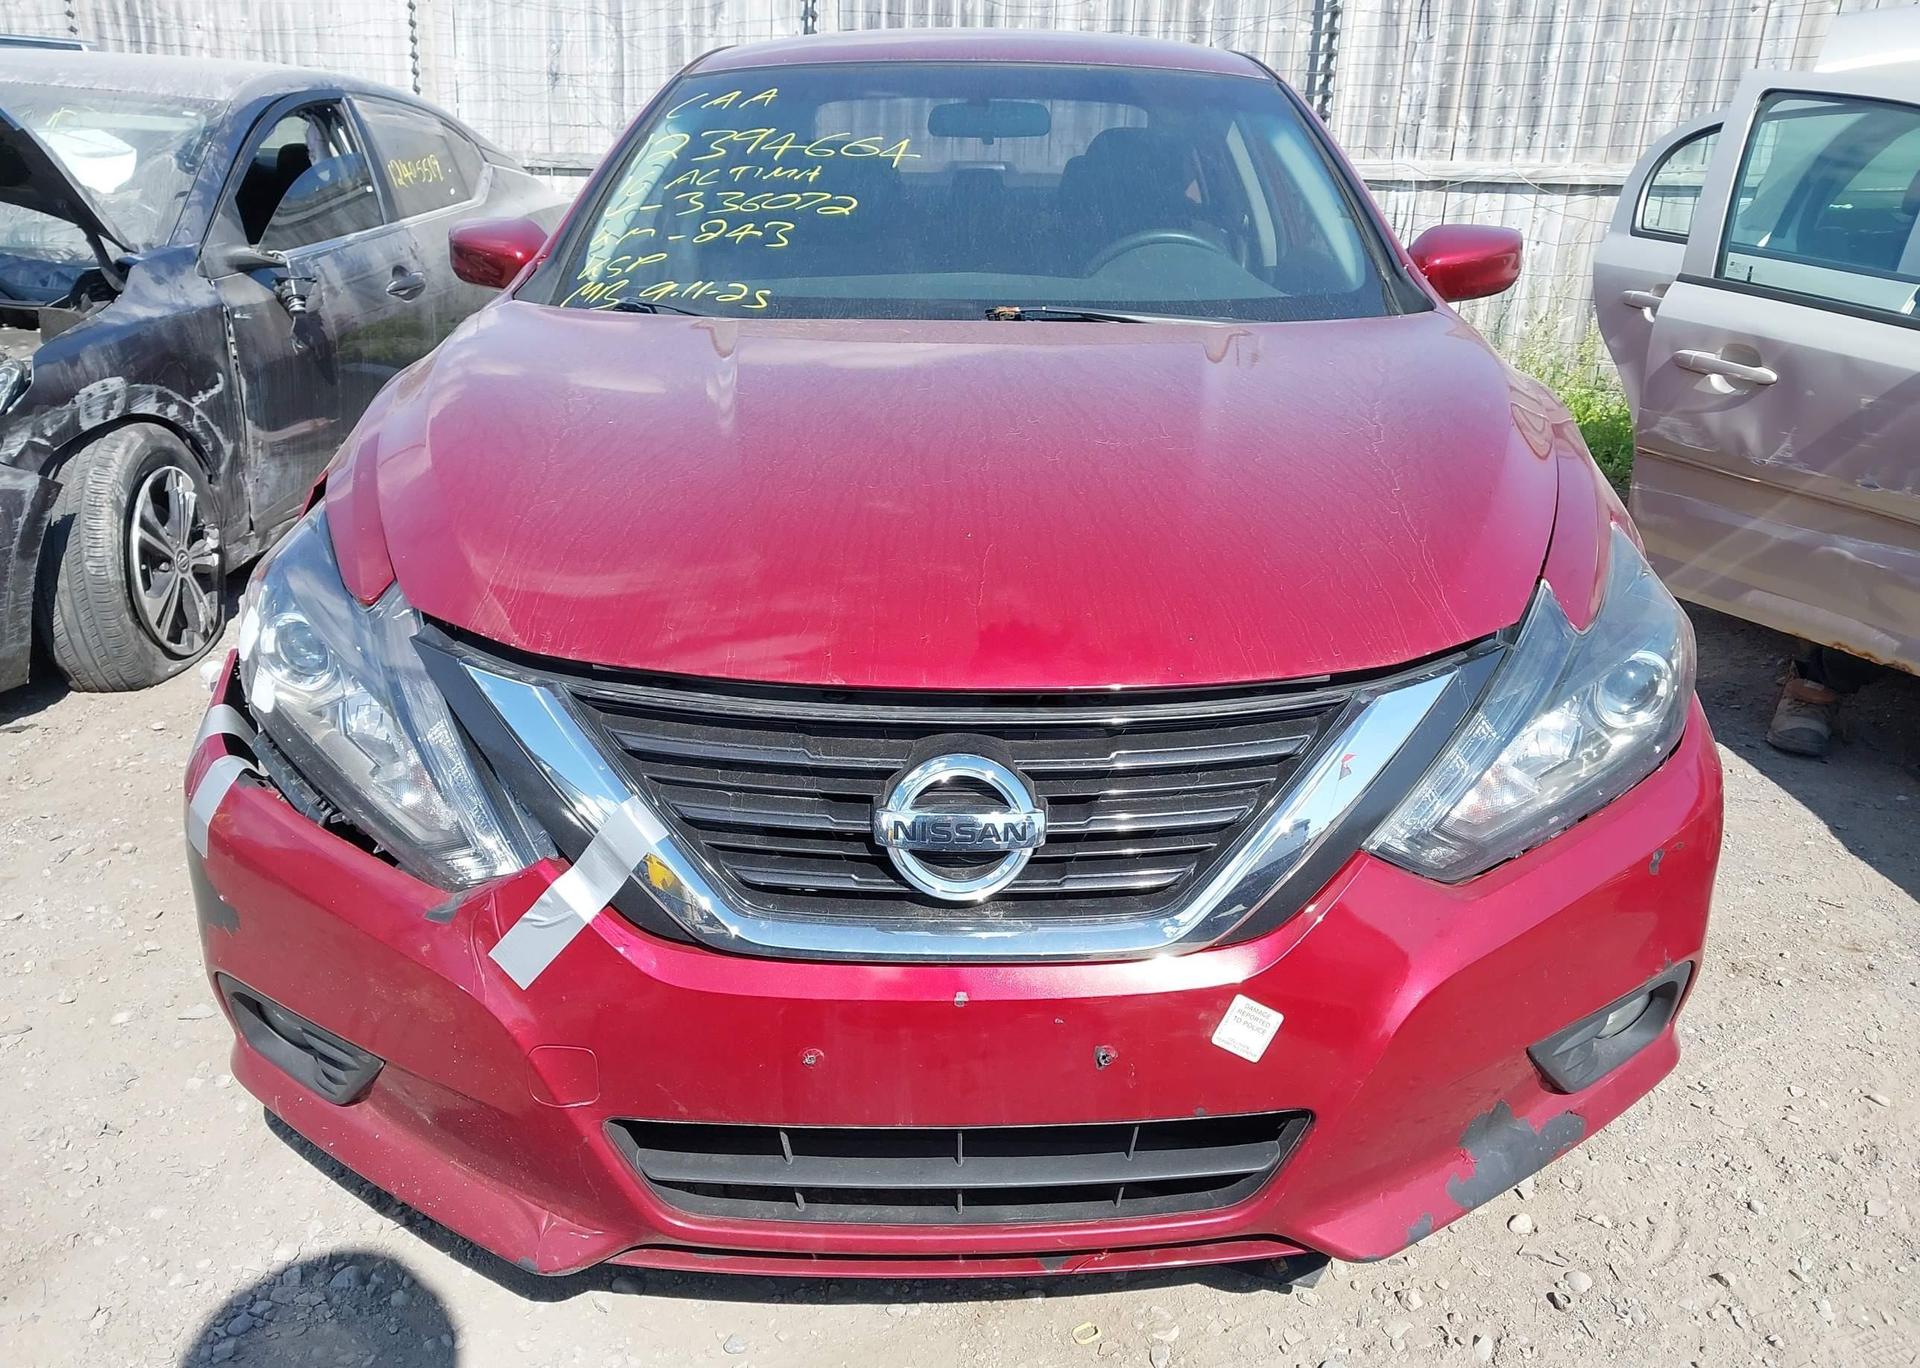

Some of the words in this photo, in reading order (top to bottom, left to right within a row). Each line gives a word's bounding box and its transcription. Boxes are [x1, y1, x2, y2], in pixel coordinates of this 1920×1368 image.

[893, 820, 1028, 844] NISSAN
[1236, 1008, 1272, 1029] REPORTED
[1243, 1002, 1273, 1020] DAMAGE
[1233, 1014, 1243, 1025] TO
[1242, 1019, 1268, 1037] POLICE
